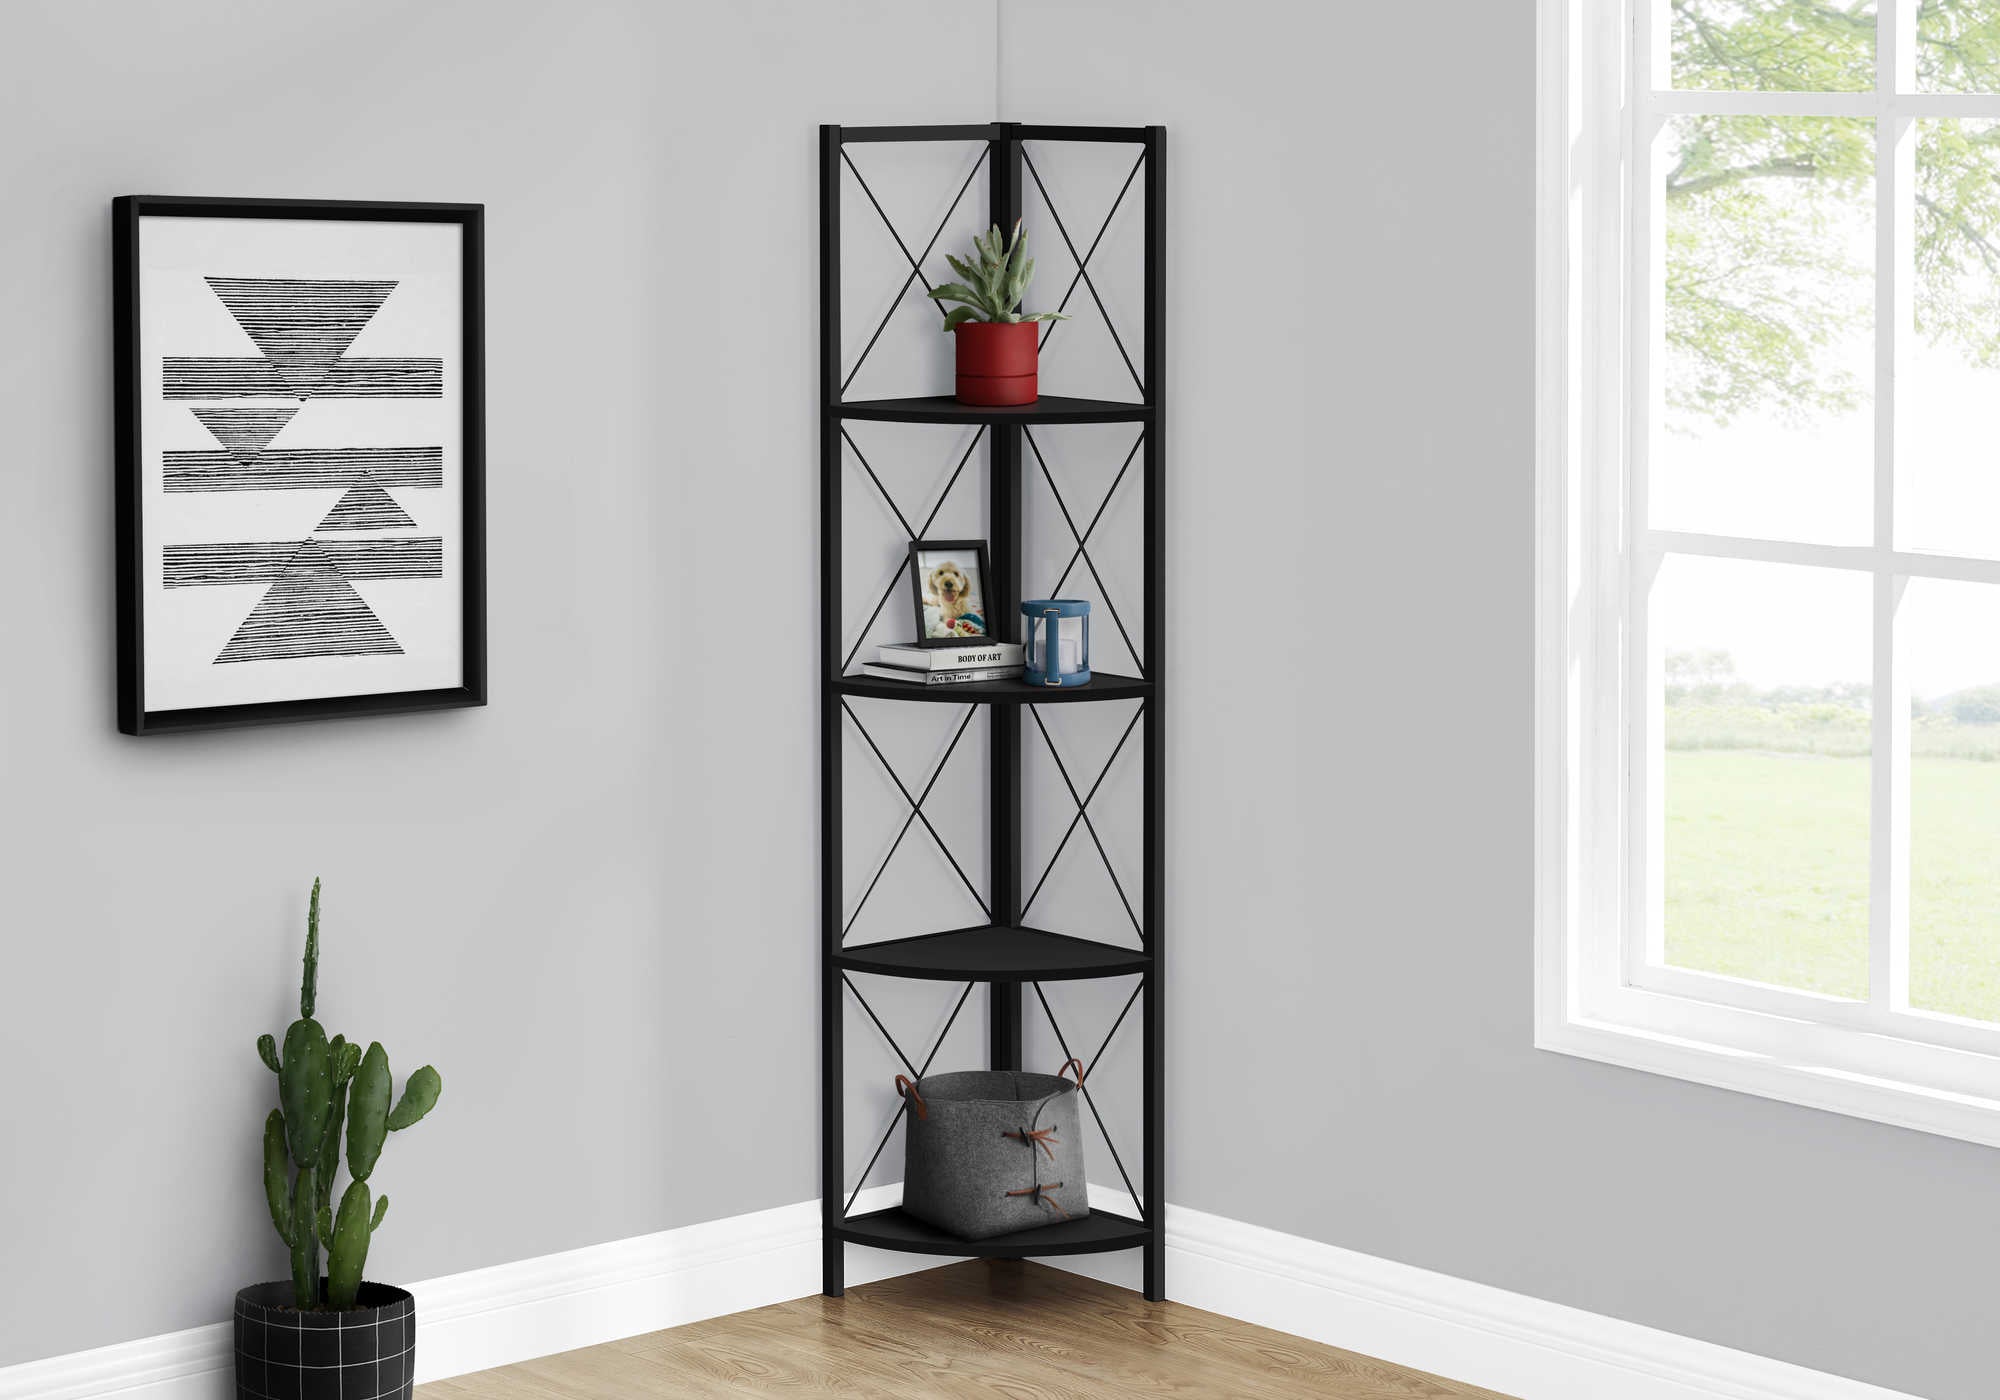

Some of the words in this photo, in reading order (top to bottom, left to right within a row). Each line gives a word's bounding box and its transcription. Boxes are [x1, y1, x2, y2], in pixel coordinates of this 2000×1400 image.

[958, 655, 976, 663] BODY
[977, 654, 987, 662] OF
[988, 653, 1002, 661] ART
